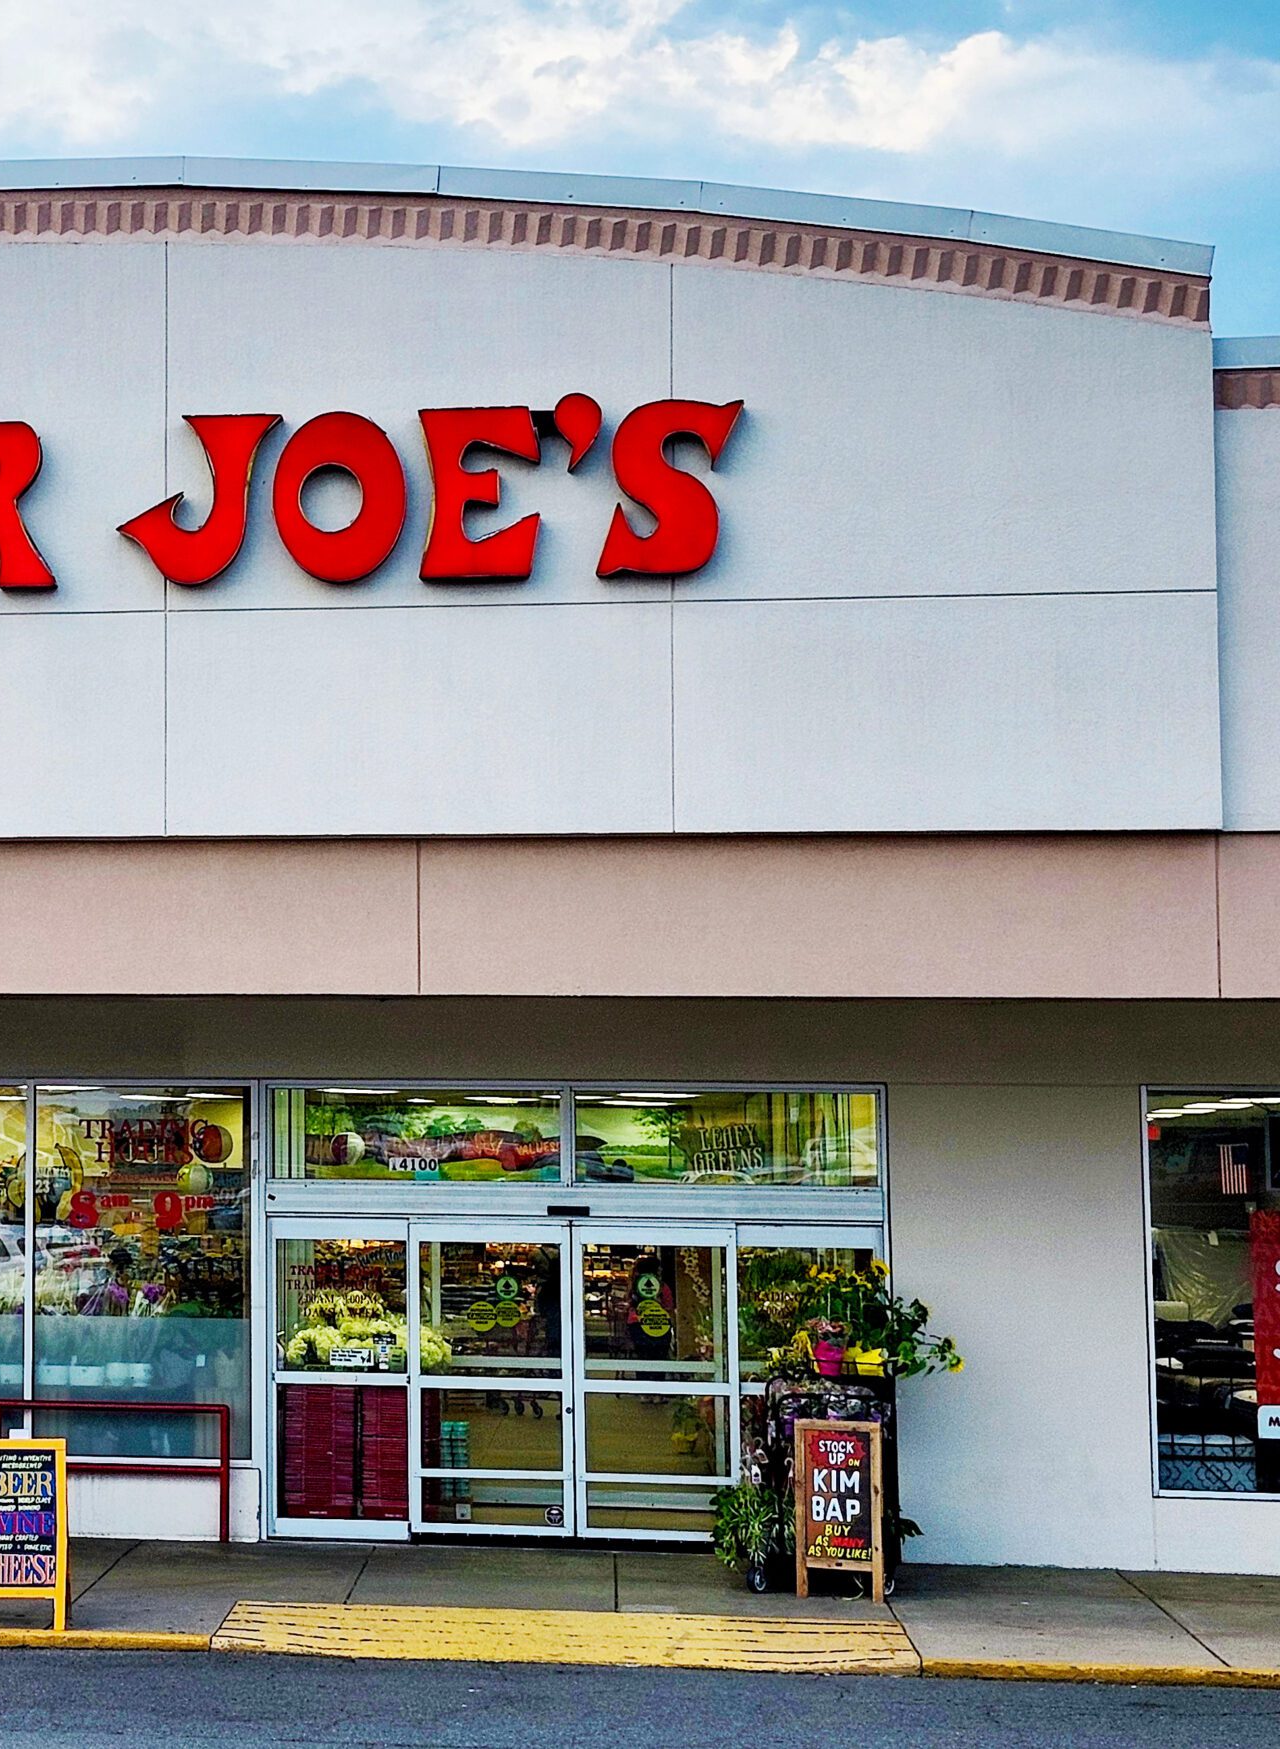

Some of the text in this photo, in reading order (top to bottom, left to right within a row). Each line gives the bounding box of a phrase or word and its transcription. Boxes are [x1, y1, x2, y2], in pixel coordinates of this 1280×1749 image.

[116, 392, 744, 586] JOE'S
[78, 1118, 208, 1139] TRADING
[698, 1123, 756, 1151] LEAFY
[95, 1141, 194, 1164] HOURS
[515, 1140, 560, 1156] VALUES!
[391, 1158, 437, 1171] 14100
[693, 1147, 764, 1175] GREENS
[818, 1440, 854, 1454] STOCK
[828, 1451, 860, 1467] UP ON
[813, 1467, 860, 1494] KIM
[811, 1495, 860, 1523] BAP
[824, 1524, 851, 1537] BUY
[815, 1535, 865, 1548] AS MANY
[807, 1545, 872, 1560] AS YOU LIKE!
